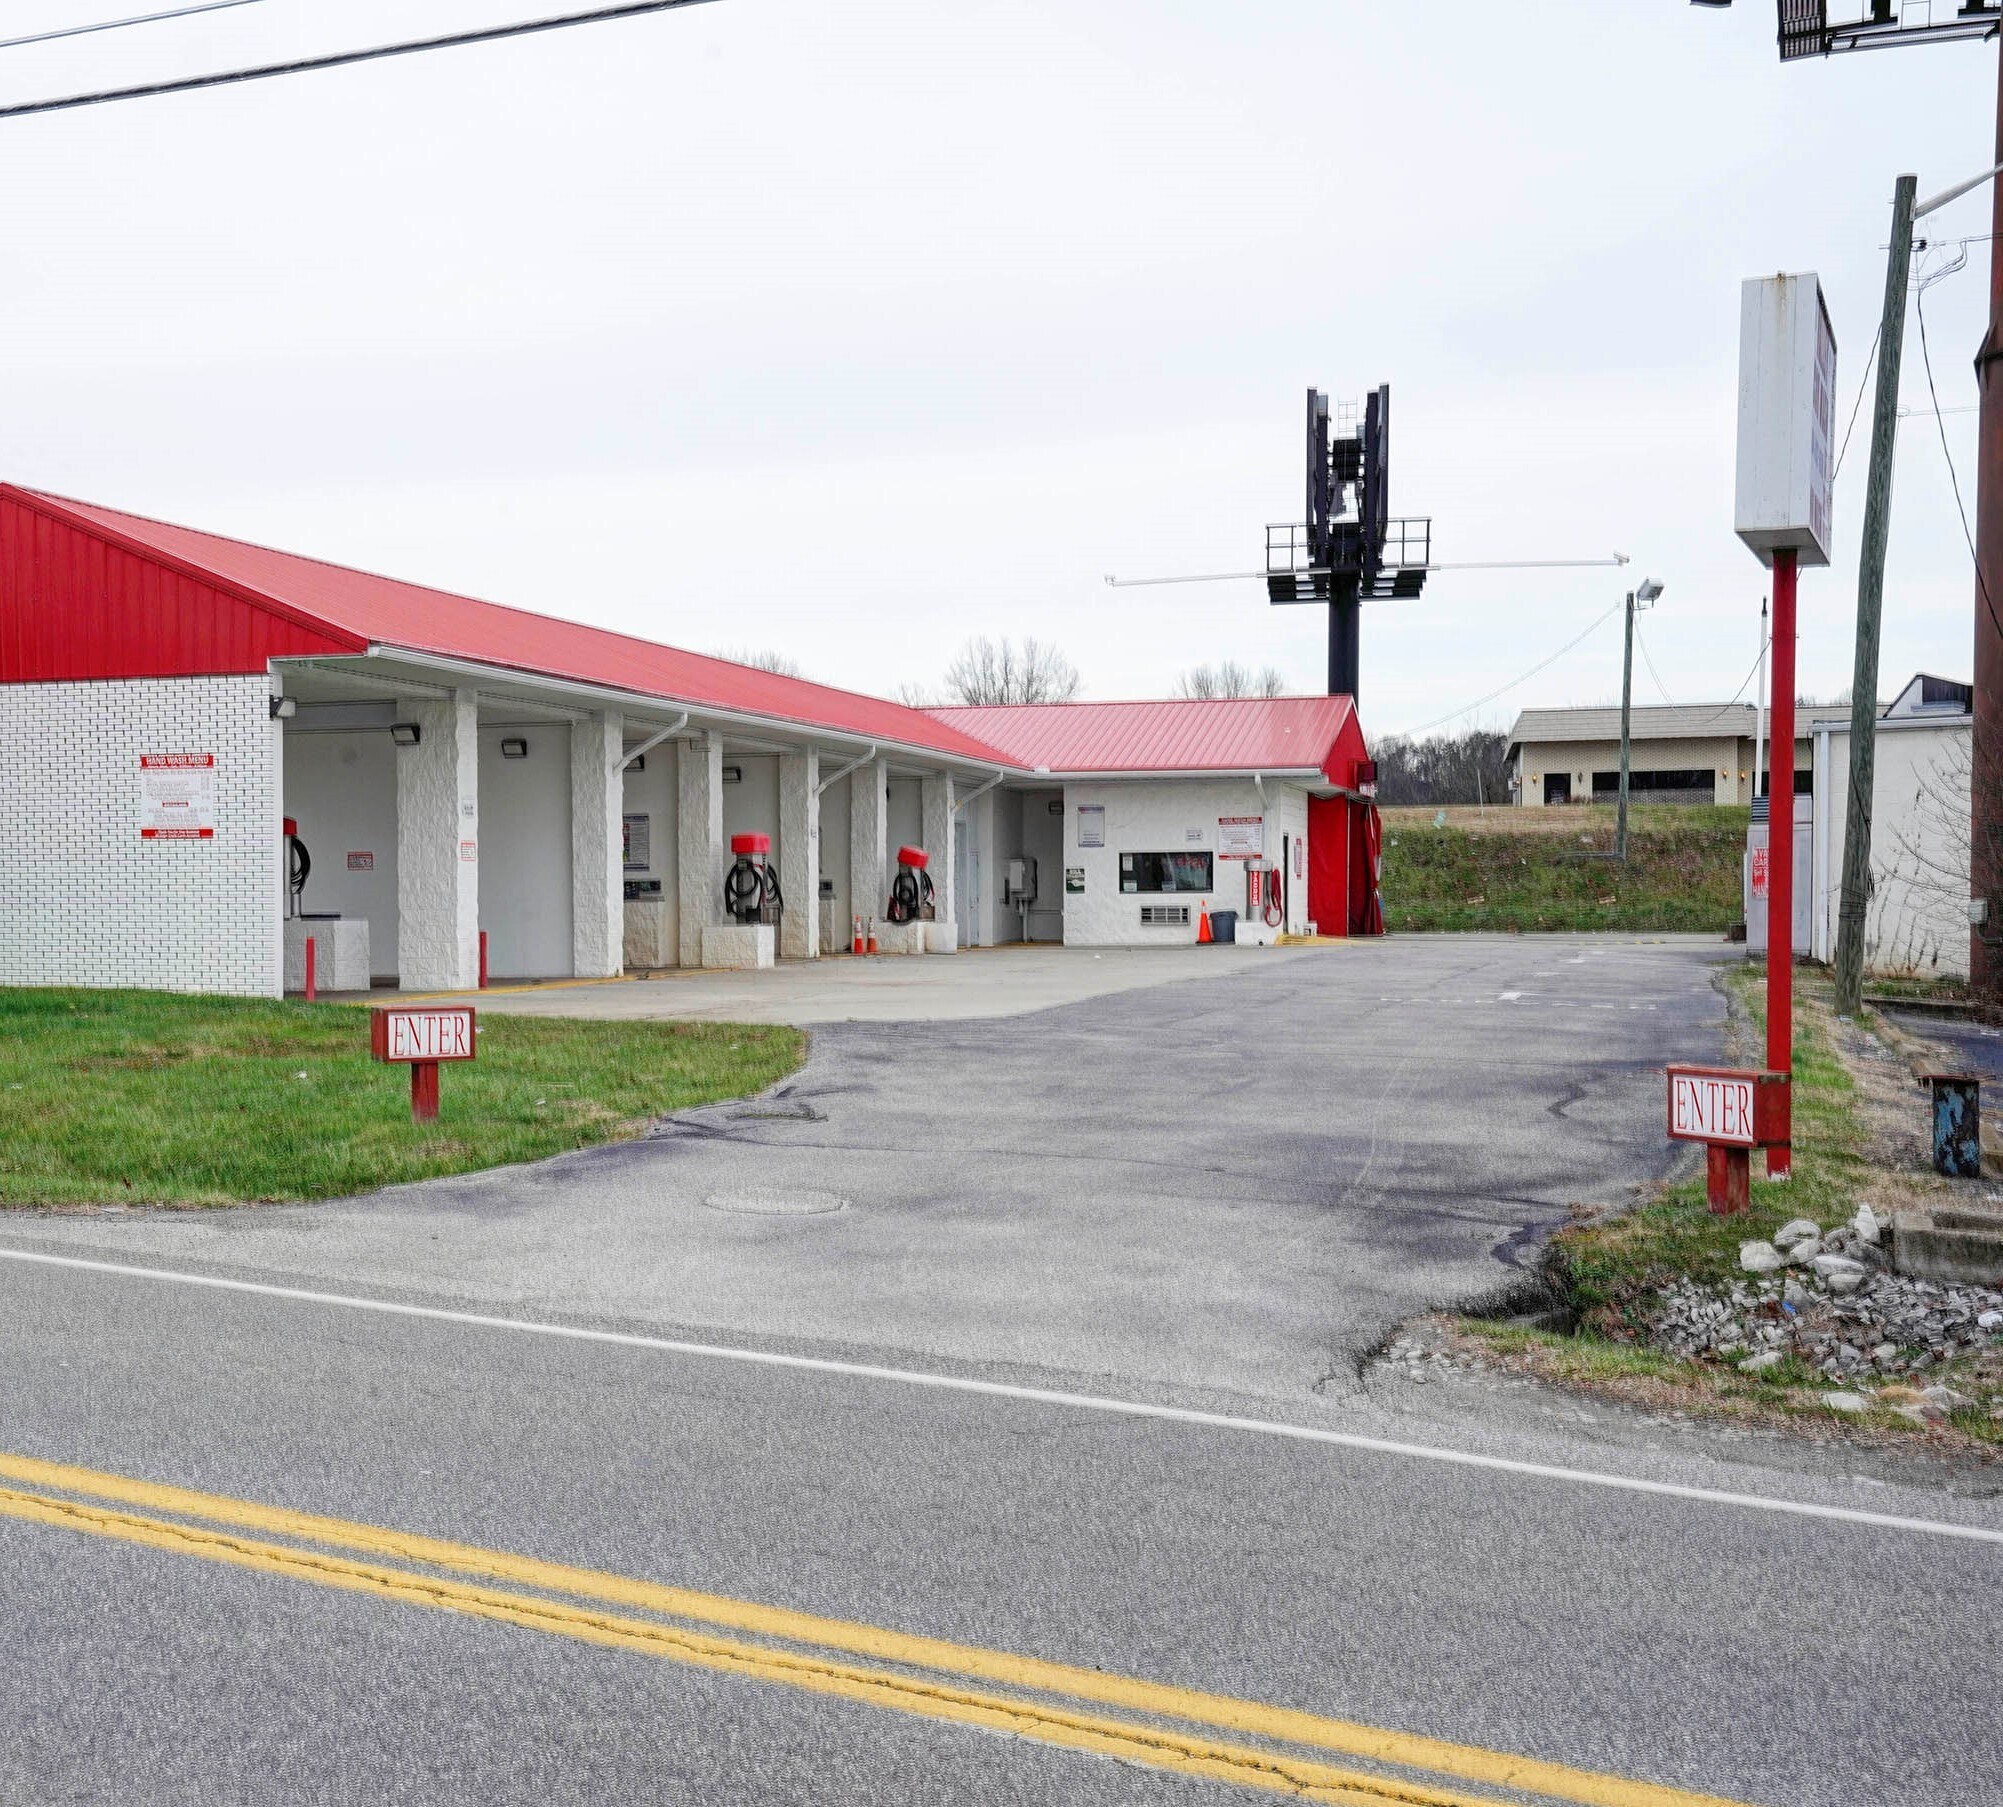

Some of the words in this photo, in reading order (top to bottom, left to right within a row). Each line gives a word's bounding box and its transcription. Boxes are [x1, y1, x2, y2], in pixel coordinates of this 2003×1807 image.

[146, 757, 166, 765] HAND
[167, 756, 187, 764] WASH
[189, 756, 209, 764] MENU
[394, 1016, 467, 1056] ENTER
[1676, 1080, 1752, 1137] ENTER
